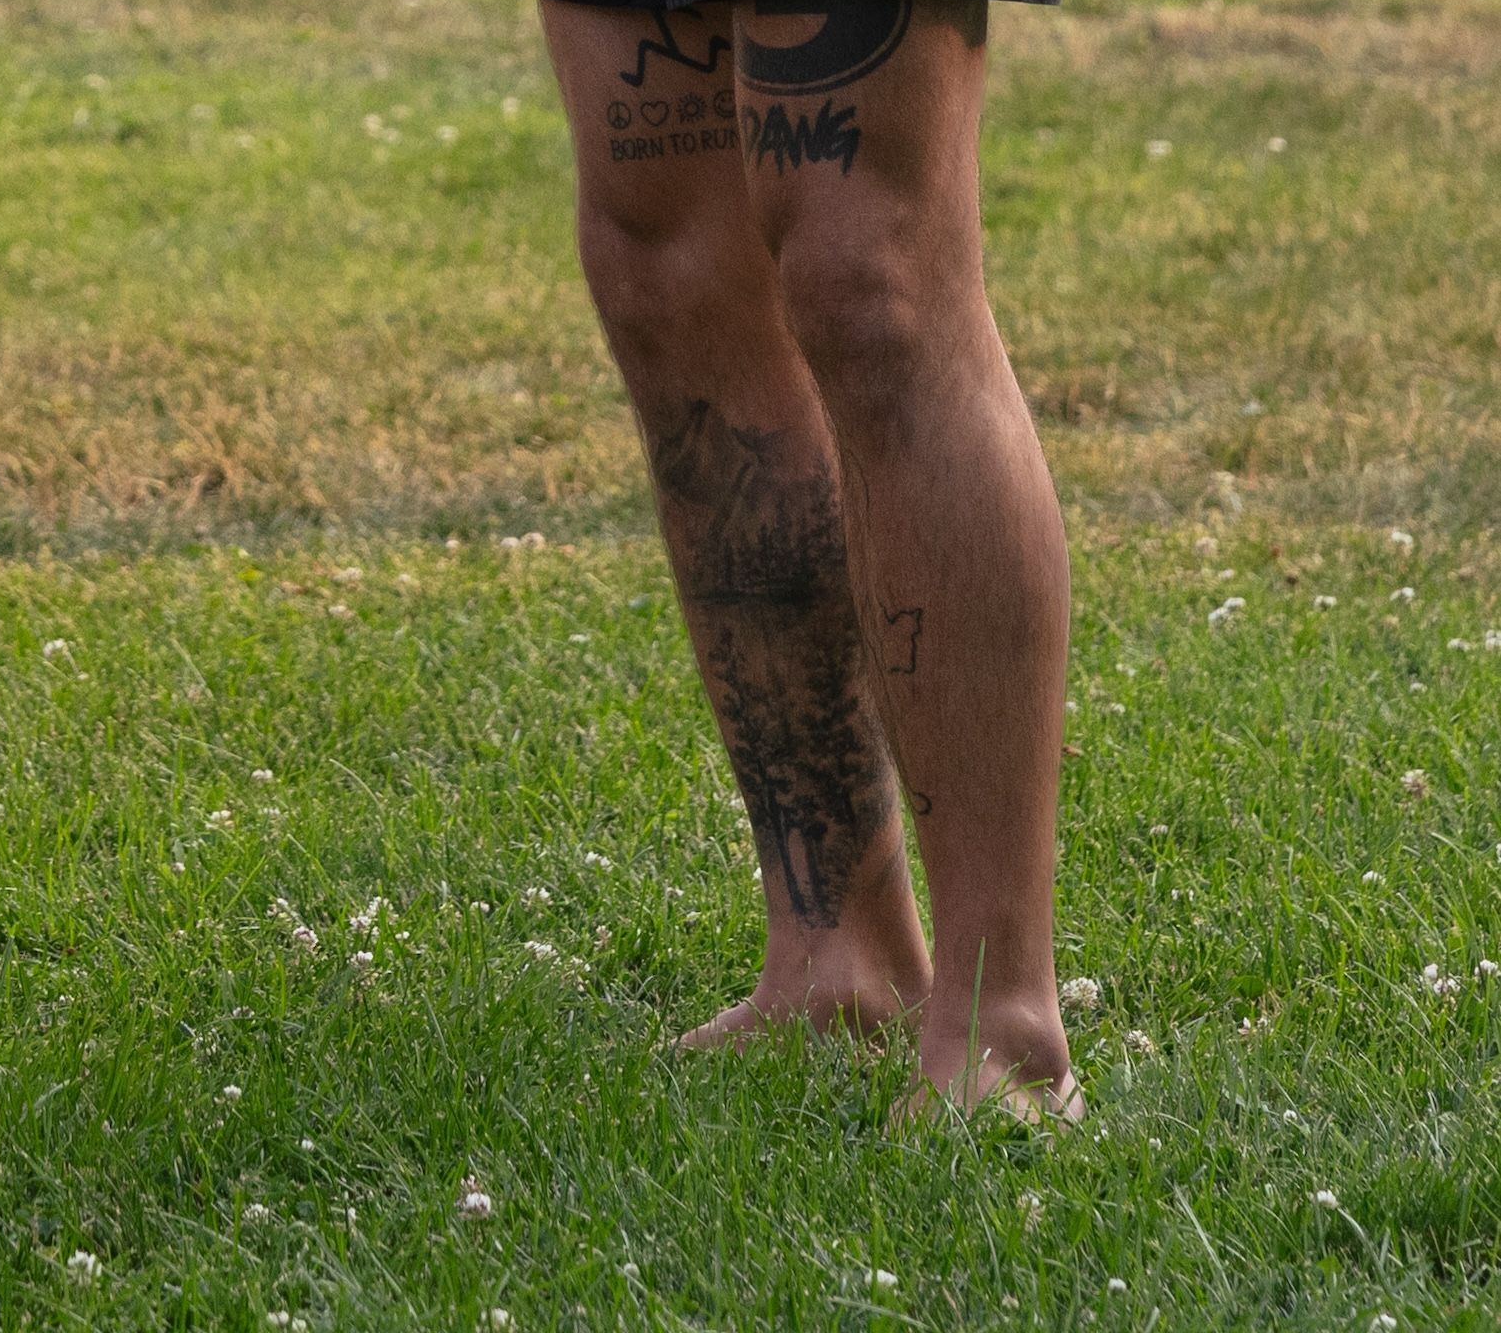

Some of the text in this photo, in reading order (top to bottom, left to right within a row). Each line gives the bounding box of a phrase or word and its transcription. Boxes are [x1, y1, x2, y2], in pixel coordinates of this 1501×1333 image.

[609, 128, 740, 162] BORN TO RUN
